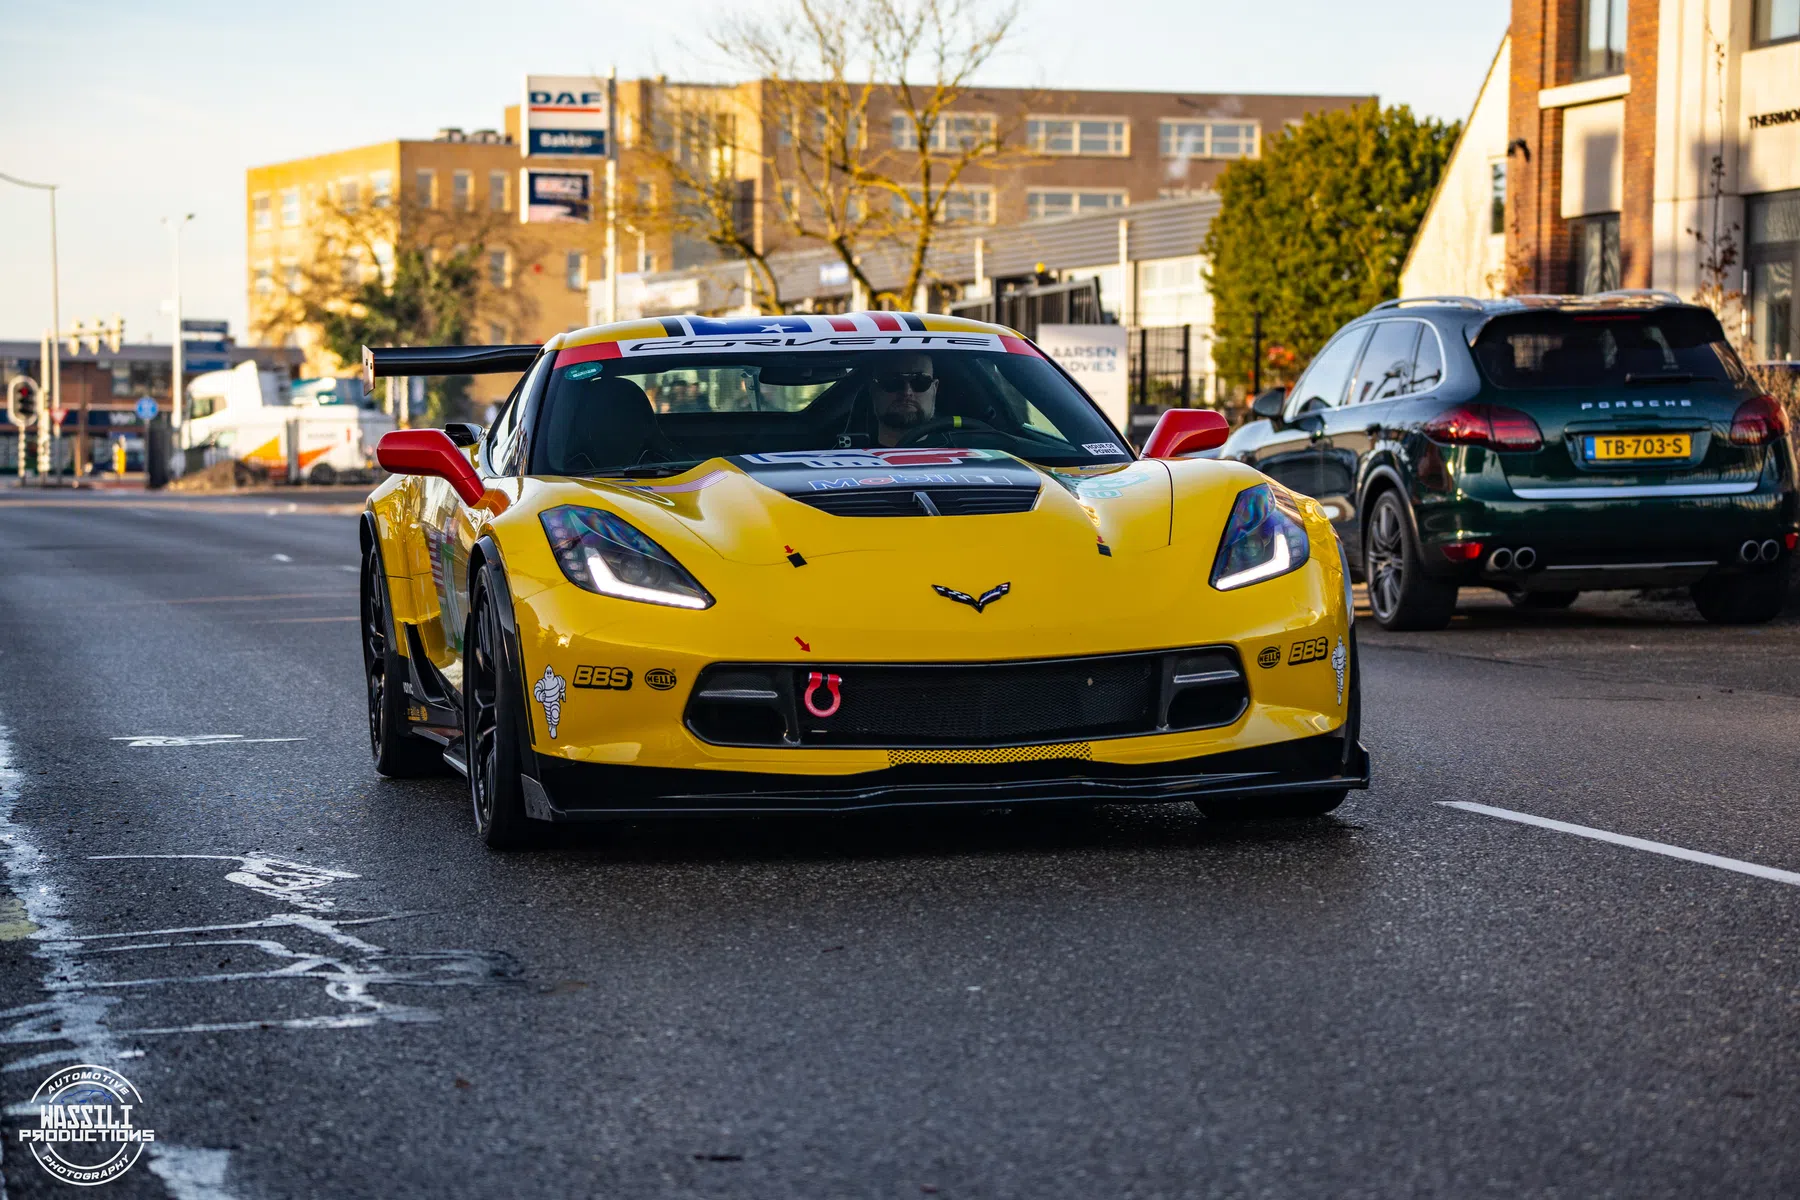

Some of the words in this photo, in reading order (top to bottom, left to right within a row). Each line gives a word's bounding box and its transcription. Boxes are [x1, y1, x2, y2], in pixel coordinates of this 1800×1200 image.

[529, 92, 602, 104] DAF
[629, 336, 990, 351] CORVETTE
[1581, 400, 1692, 410] PORSCHE
[1602, 438, 1684, 455] TB-703-S
[808, 474, 957, 490] Mobil
[1259, 651, 1281, 663] HELLA
[1288, 636, 1328, 666] BBS
[572, 665, 634, 691] BBS
[646, 675, 677, 686] HELLA
